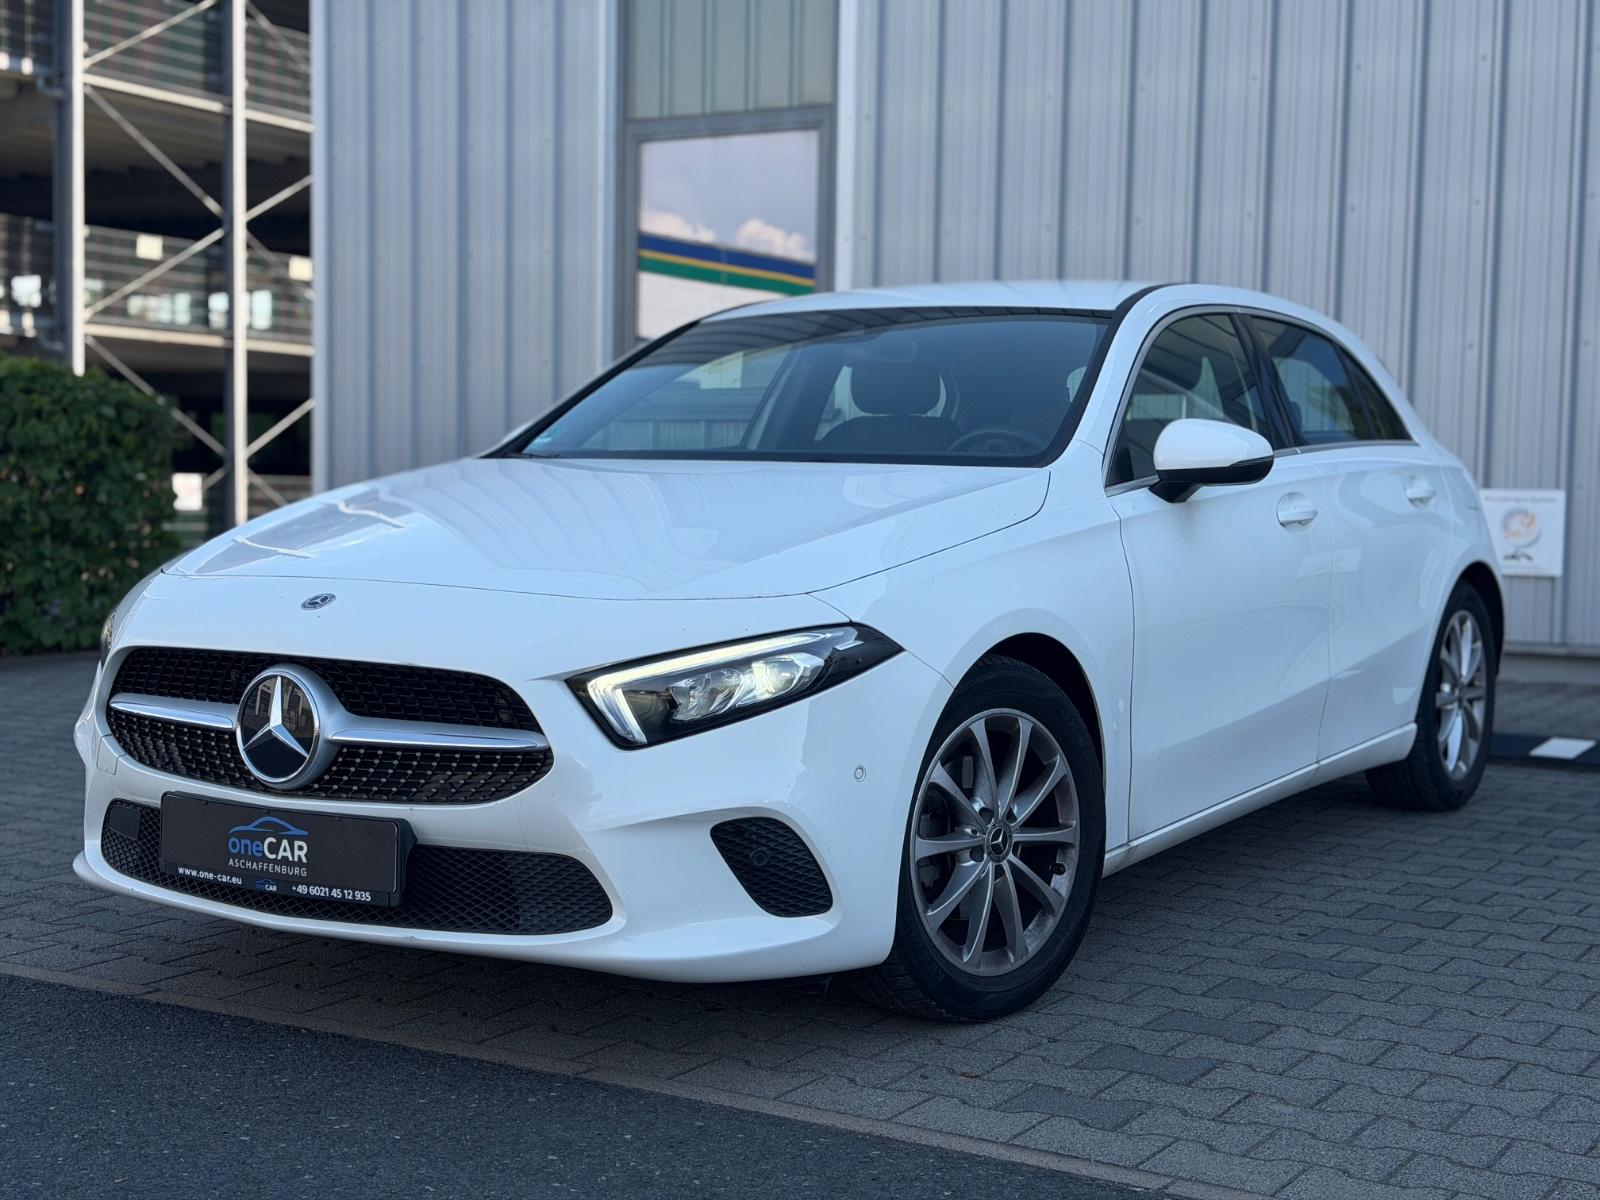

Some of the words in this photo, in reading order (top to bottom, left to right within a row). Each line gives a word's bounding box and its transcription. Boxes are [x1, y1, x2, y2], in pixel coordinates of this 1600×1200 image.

[228, 837, 308, 863] oneCAR
[178, 866, 242, 885] www.one-car.eu
[228, 858, 308, 877] ASCHAFFENBURG
[292, 884, 307, 894] +49
[308, 885, 330, 897] 6021
[330, 888, 342, 898] 45
[343, 890, 353, 899] 12
[354, 890, 371, 901] 935
